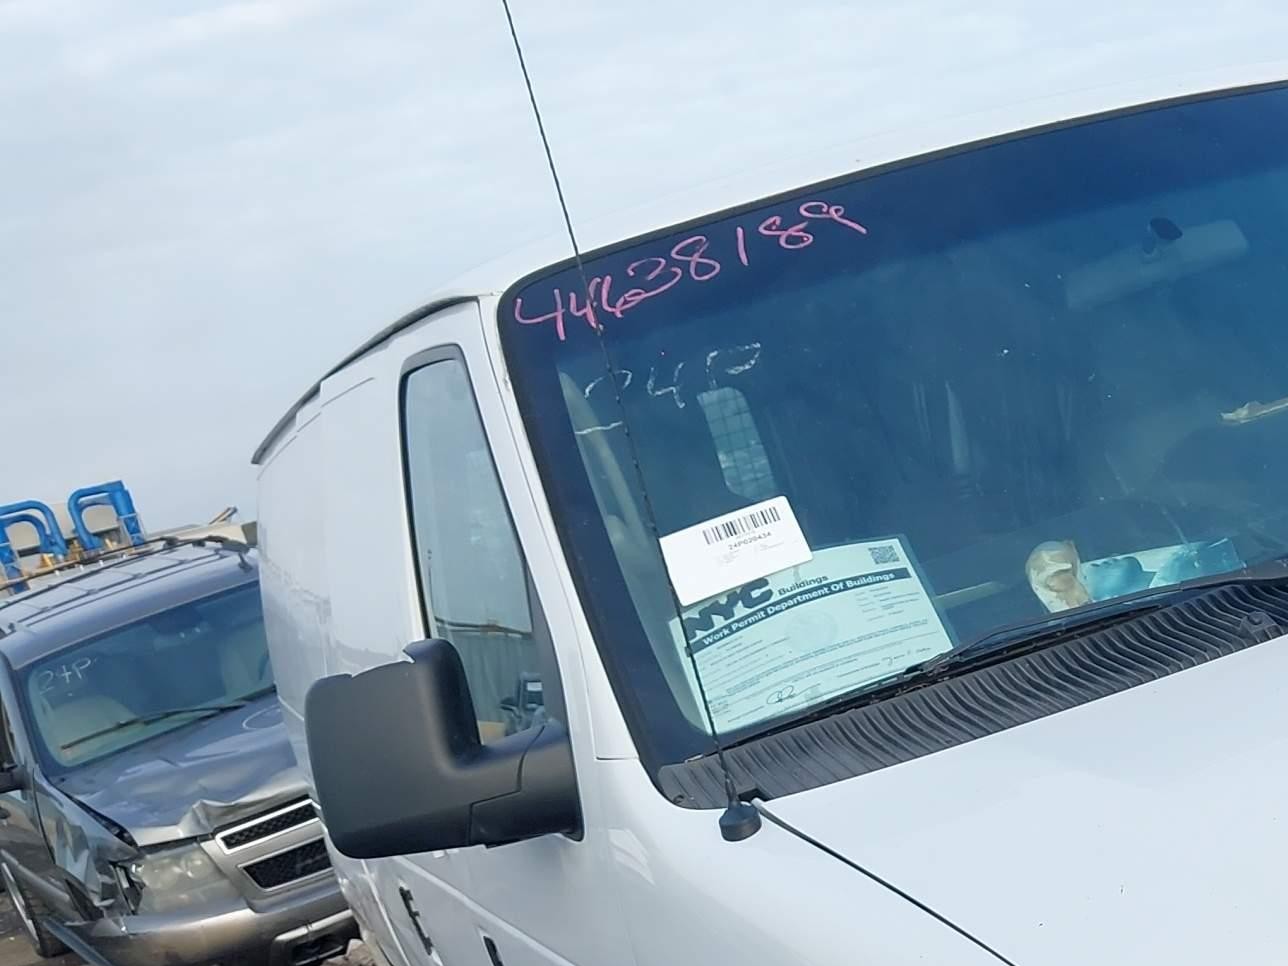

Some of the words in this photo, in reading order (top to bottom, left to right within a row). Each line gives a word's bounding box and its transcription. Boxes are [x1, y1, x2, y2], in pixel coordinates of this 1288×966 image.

[684, 577, 773, 640] NYC
[703, 628, 731, 645] Work
[731, 611, 766, 631] Permit
[767, 587, 829, 615] Department
[831, 581, 845, 592] Of
[846, 572, 896, 588] Buildings
[777, 575, 829, 596] Buildings
